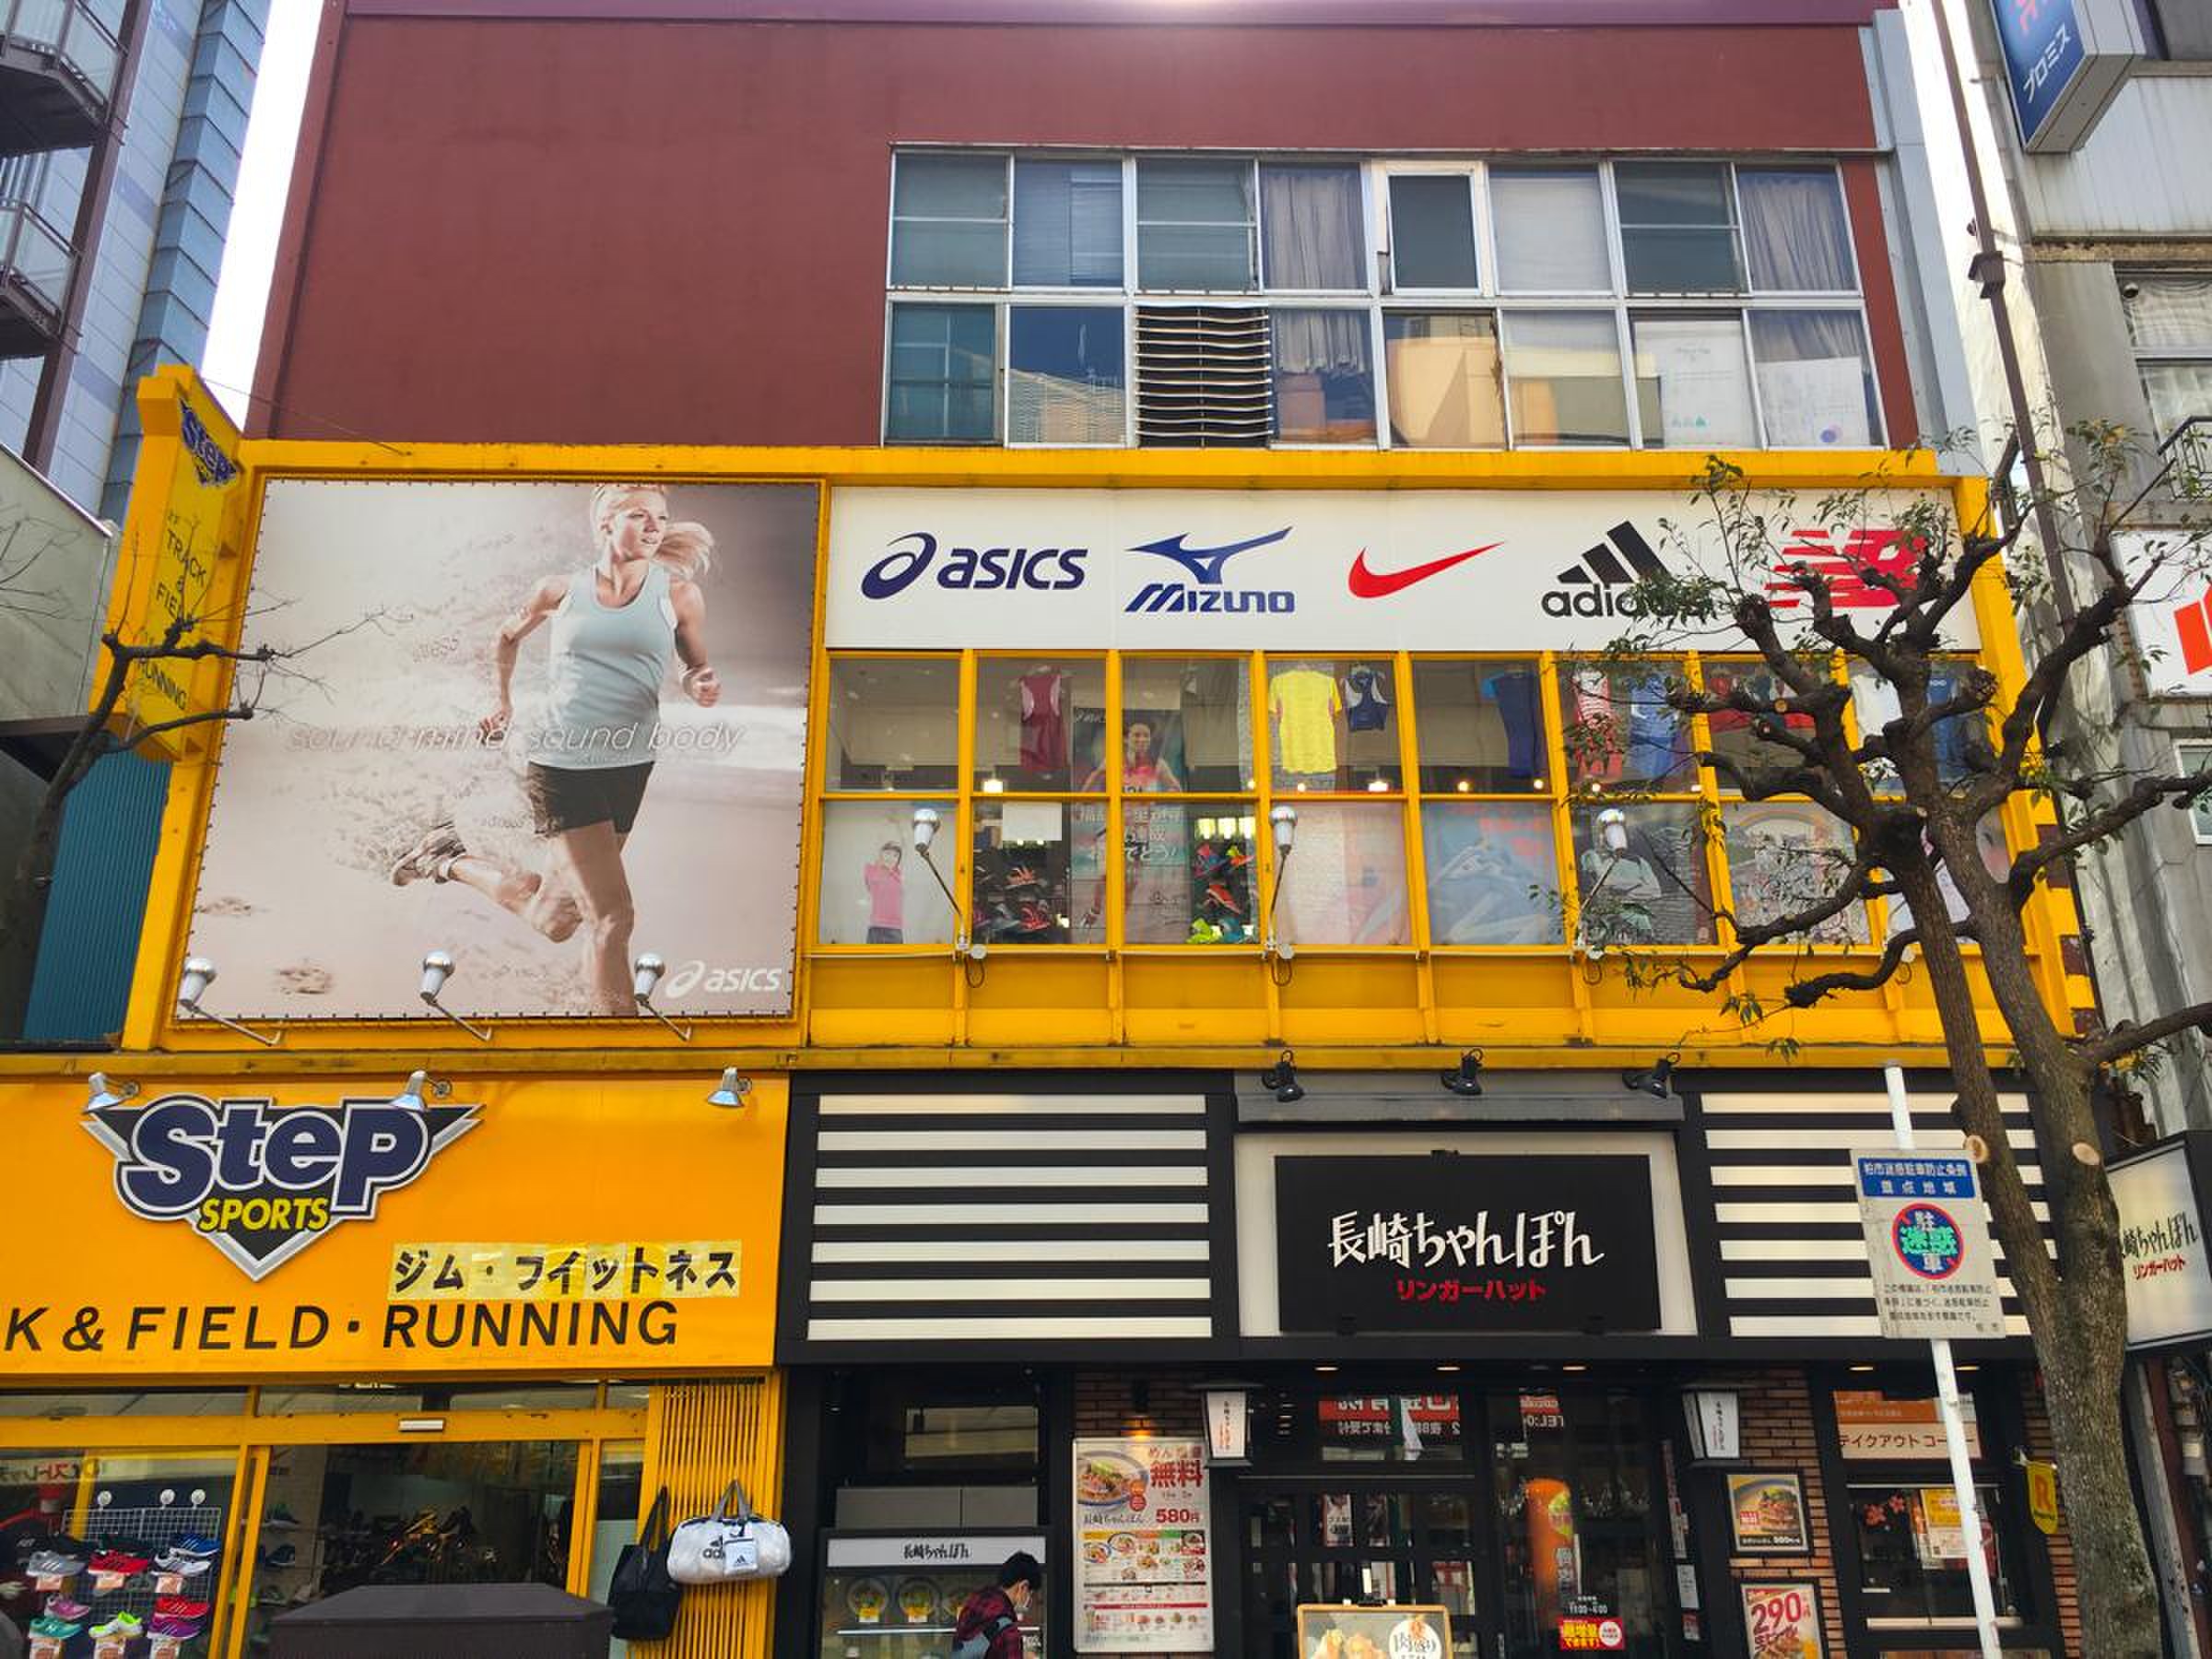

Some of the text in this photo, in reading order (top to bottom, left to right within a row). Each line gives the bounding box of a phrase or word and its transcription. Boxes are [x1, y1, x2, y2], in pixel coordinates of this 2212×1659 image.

[2022, 22, 2072, 103] プロミス
[648, 721, 743, 755] body
[703, 968, 783, 994] asics
[120, 1095, 430, 1214] Step
[198, 1197, 329, 1231] SPORTS
[1327, 1209, 1606, 1269] 長崎ちゃんぽん
[2122, 1211, 2197, 1259] 崎ちゃんぽん
[1395, 1278, 1547, 1300] リンガーハット
[62, 1306, 105, 1352] &
[126, 1304, 330, 1351] FIELD
[382, 1300, 678, 1348] RUNNING
[1839, 1433, 1975, 1450] テイクアウトコーー
[1149, 1459, 1204, 1488] 無料
